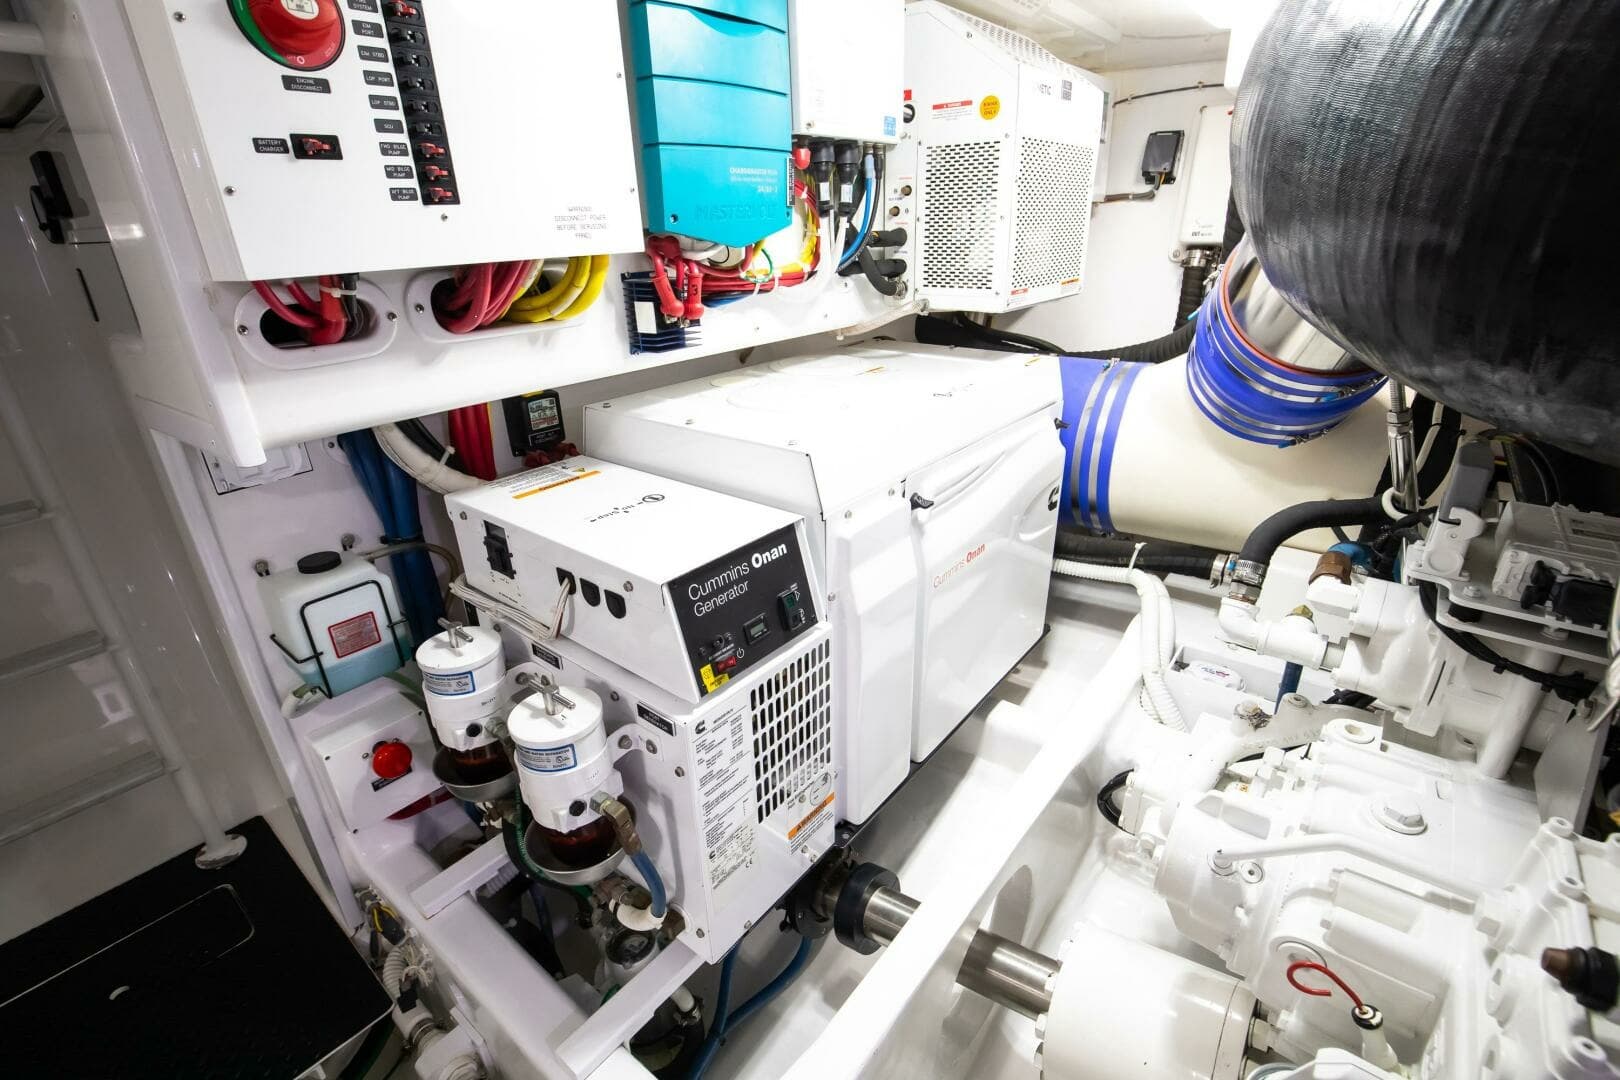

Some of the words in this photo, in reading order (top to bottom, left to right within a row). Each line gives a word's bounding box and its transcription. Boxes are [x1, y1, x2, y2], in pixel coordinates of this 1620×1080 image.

[291, 83, 323, 91] DISCONNECT
[688, 562, 750, 601] Cummins
[751, 543, 788, 569] Onan
[933, 558, 966, 589] Cummins
[966, 543, 986, 563] Onan
[693, 580, 749, 617] Generator
